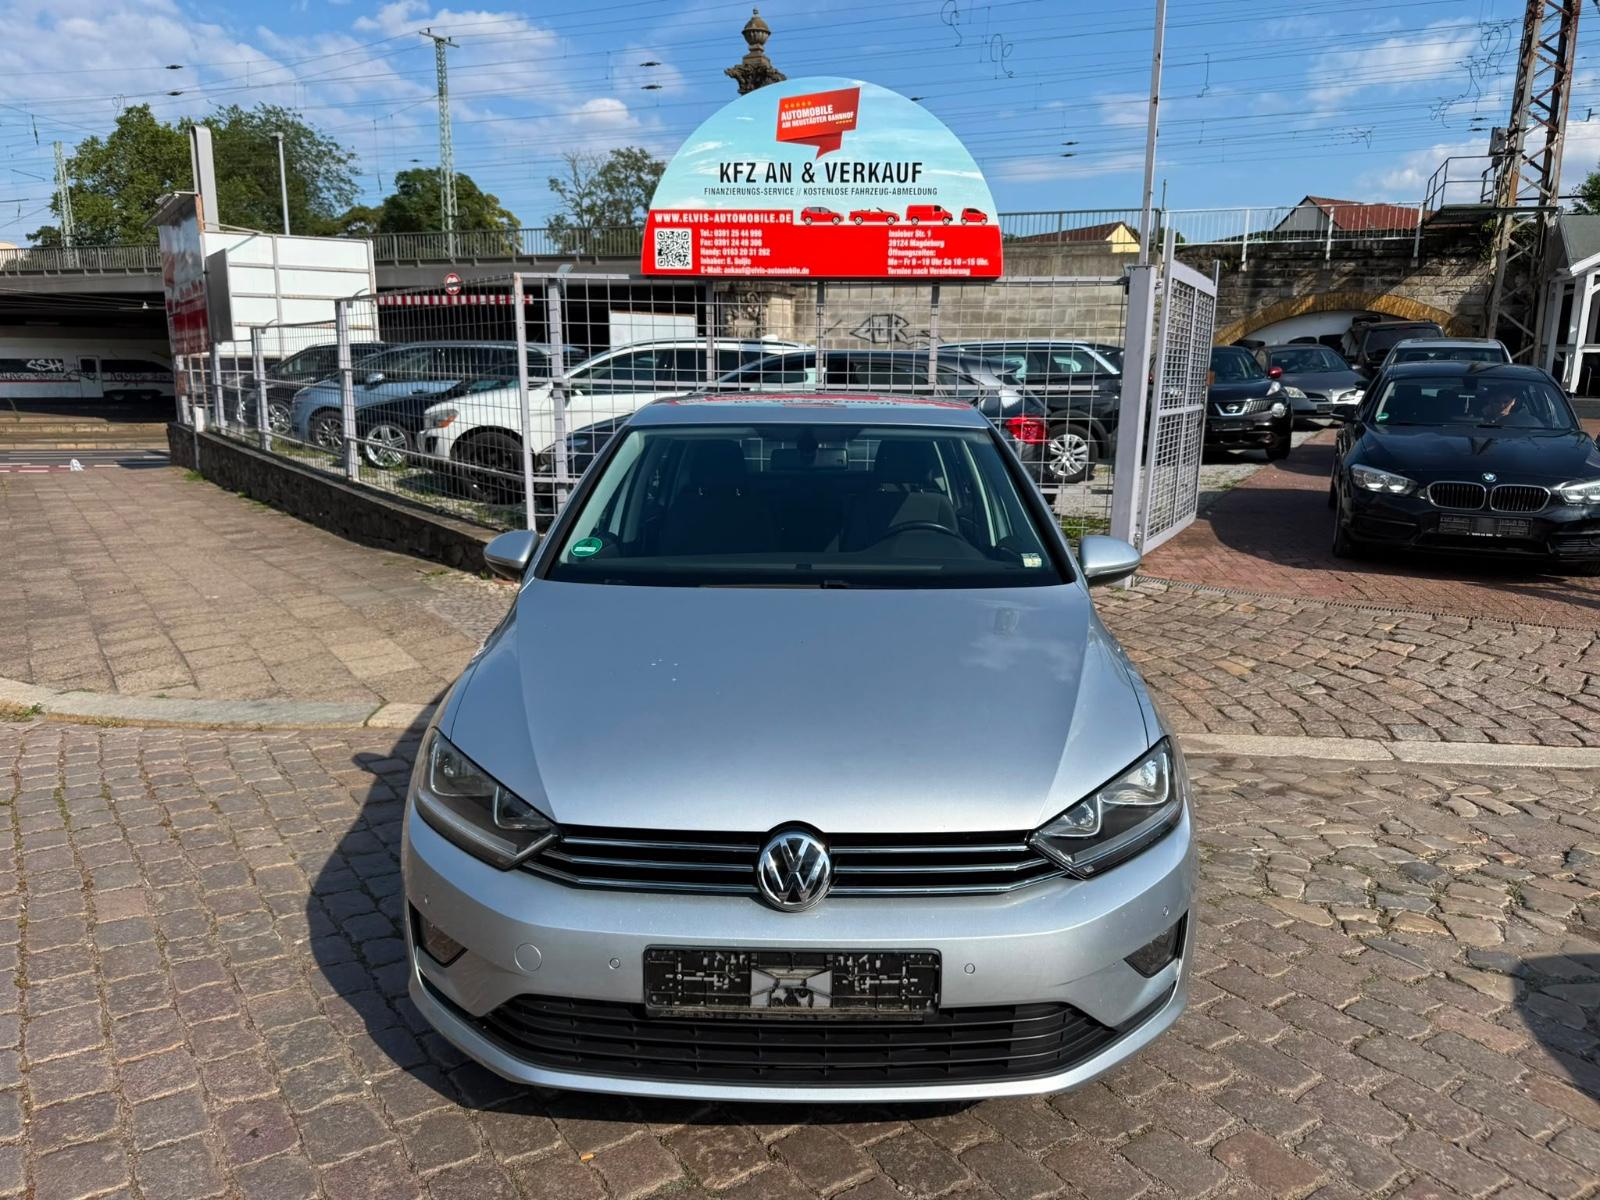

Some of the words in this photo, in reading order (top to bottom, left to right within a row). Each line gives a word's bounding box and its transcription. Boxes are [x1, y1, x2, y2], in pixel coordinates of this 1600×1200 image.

[781, 104, 834, 120] AUTOMOBILE
[781, 120, 791, 128] AM
[791, 115, 827, 127] NEUSTÄDTER
[827, 111, 854, 122] BAHNHOF
[720, 162, 757, 183] KFZ
[765, 162, 792, 183] AN
[801, 161, 815, 183] &
[824, 162, 922, 183] VERKAUF
[704, 187, 794, 196] FINANZIERUNGS-SERVICE
[803, 187, 848, 196] KOSTENLOSE
[851, 187, 938, 196] FAHRZEUG-ABMELDUNG
[654, 212, 792, 223] WWW.ELVIS-AUTOMOBILE.DE
[740, 229, 749, 237] 44
[915, 229, 926, 238] Str.
[910, 239, 945, 248] Magdeburg
[700, 248, 721, 257] Handy:
[887, 247, 937, 257] Öffnungszeiten:
[700, 257, 726, 265] Inhaber:
[931, 258, 942, 266] Uhr
[888, 267, 911, 275] Termine
[913, 267, 928, 275] nach
[929, 267, 970, 276] Vereinbarung
[759, 833, 829, 909] VW
